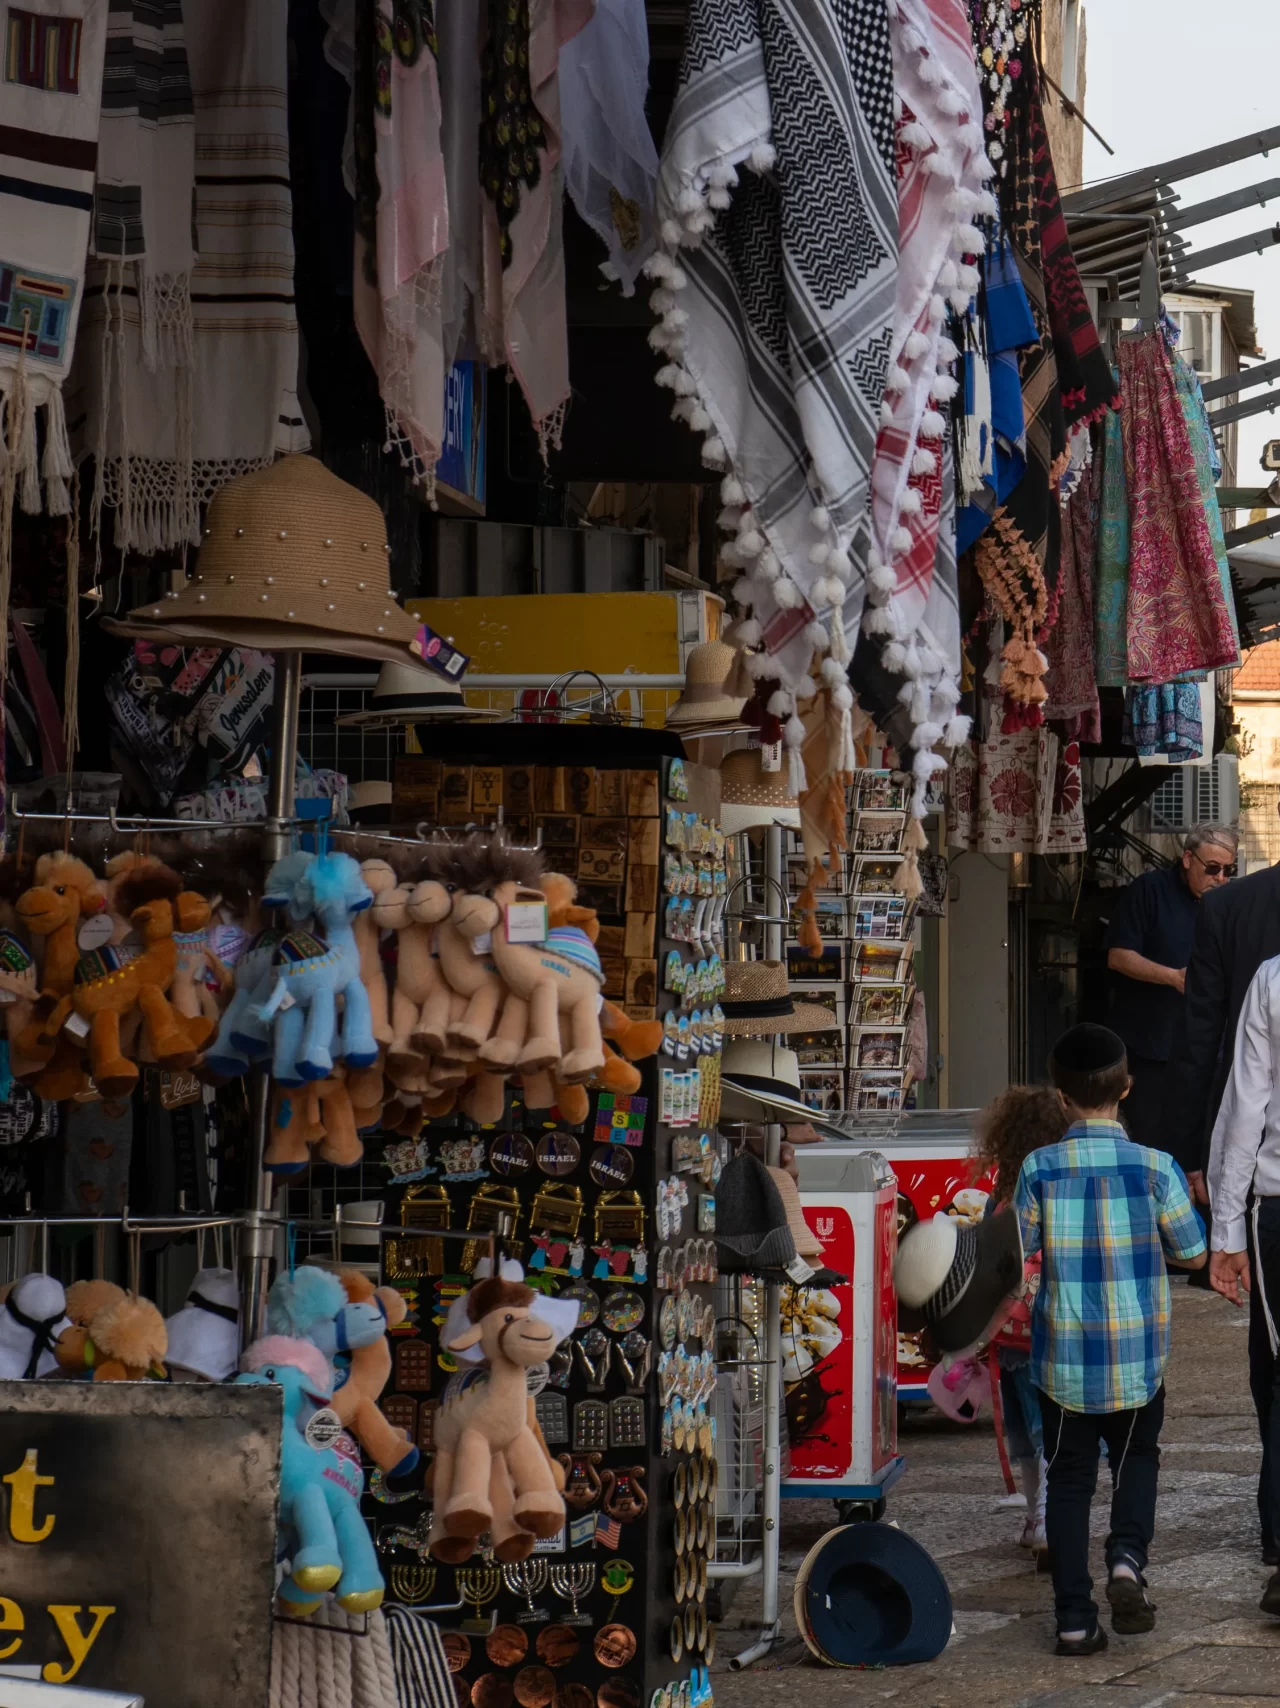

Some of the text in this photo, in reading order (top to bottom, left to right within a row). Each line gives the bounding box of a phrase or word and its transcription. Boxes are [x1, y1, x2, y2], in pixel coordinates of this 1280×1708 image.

[443, 366, 466, 453] ERY
[218, 667, 274, 743] Jerusalem
[491, 1151, 530, 1168] ISRAEL
[538, 1154, 577, 1163] ISRAEL
[590, 1159, 628, 1182] ISRAEL
[307, 1424, 341, 1434] Original
